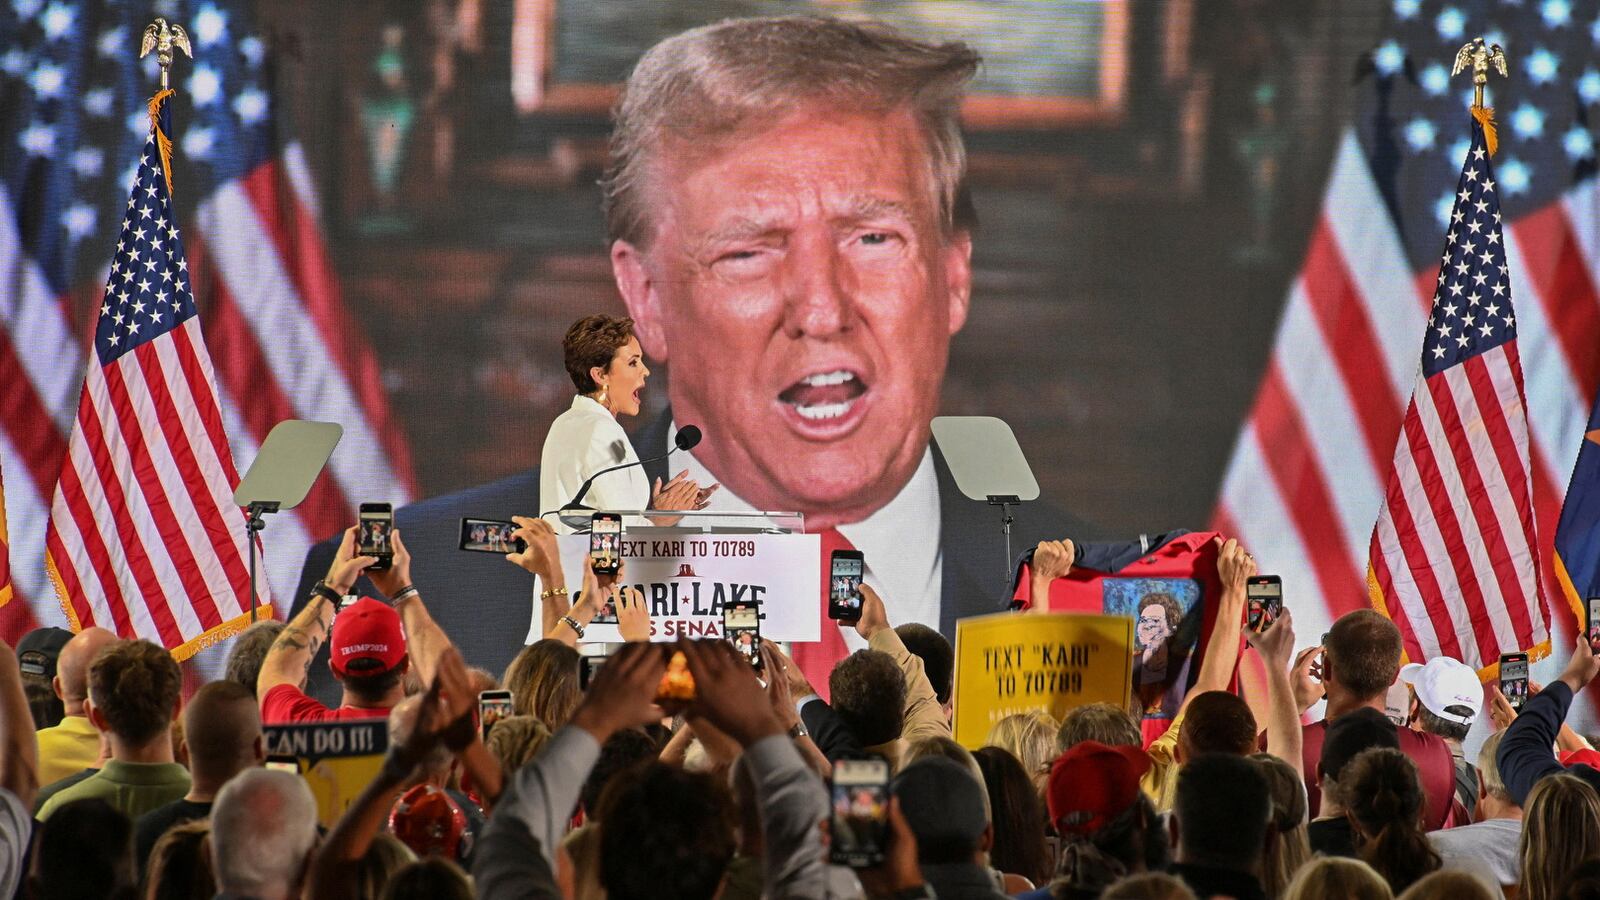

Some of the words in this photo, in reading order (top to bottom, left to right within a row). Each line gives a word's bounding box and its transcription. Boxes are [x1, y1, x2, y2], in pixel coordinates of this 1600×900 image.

[620, 541, 647, 557] EXT
[652, 541, 685, 557] KARI
[690, 541, 707, 557] TO
[712, 541, 755, 557] 70789
[692, 582, 767, 619] LAKE
[664, 620, 725, 636] SENA
[983, 644, 1024, 671] TEXT
[997, 673, 1016, 698] TO
[1024, 671, 1083, 695] 70789
[265, 729, 307, 755] CAN
[314, 728, 345, 754] DO
[351, 726, 373, 751] IT!
